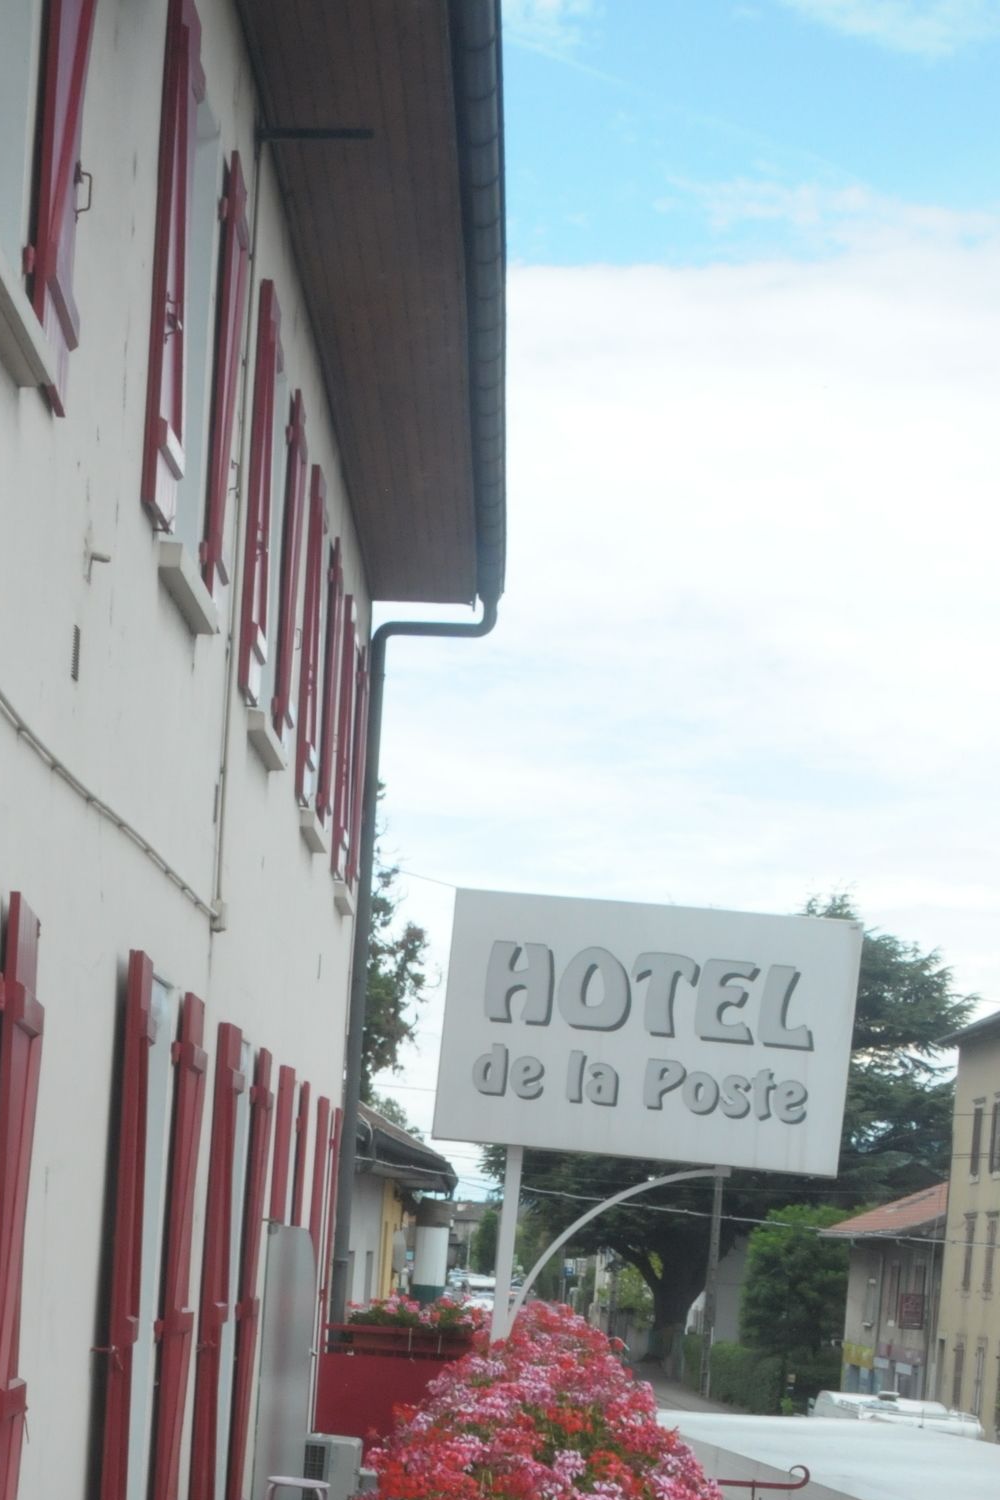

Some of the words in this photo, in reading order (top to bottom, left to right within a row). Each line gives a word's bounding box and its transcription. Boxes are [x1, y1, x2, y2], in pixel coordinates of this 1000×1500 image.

[486, 940, 814, 1051] HOTEL
[473, 1043, 545, 1099] de
[567, 1050, 619, 1106] la
[644, 1058, 808, 1124] Poste
